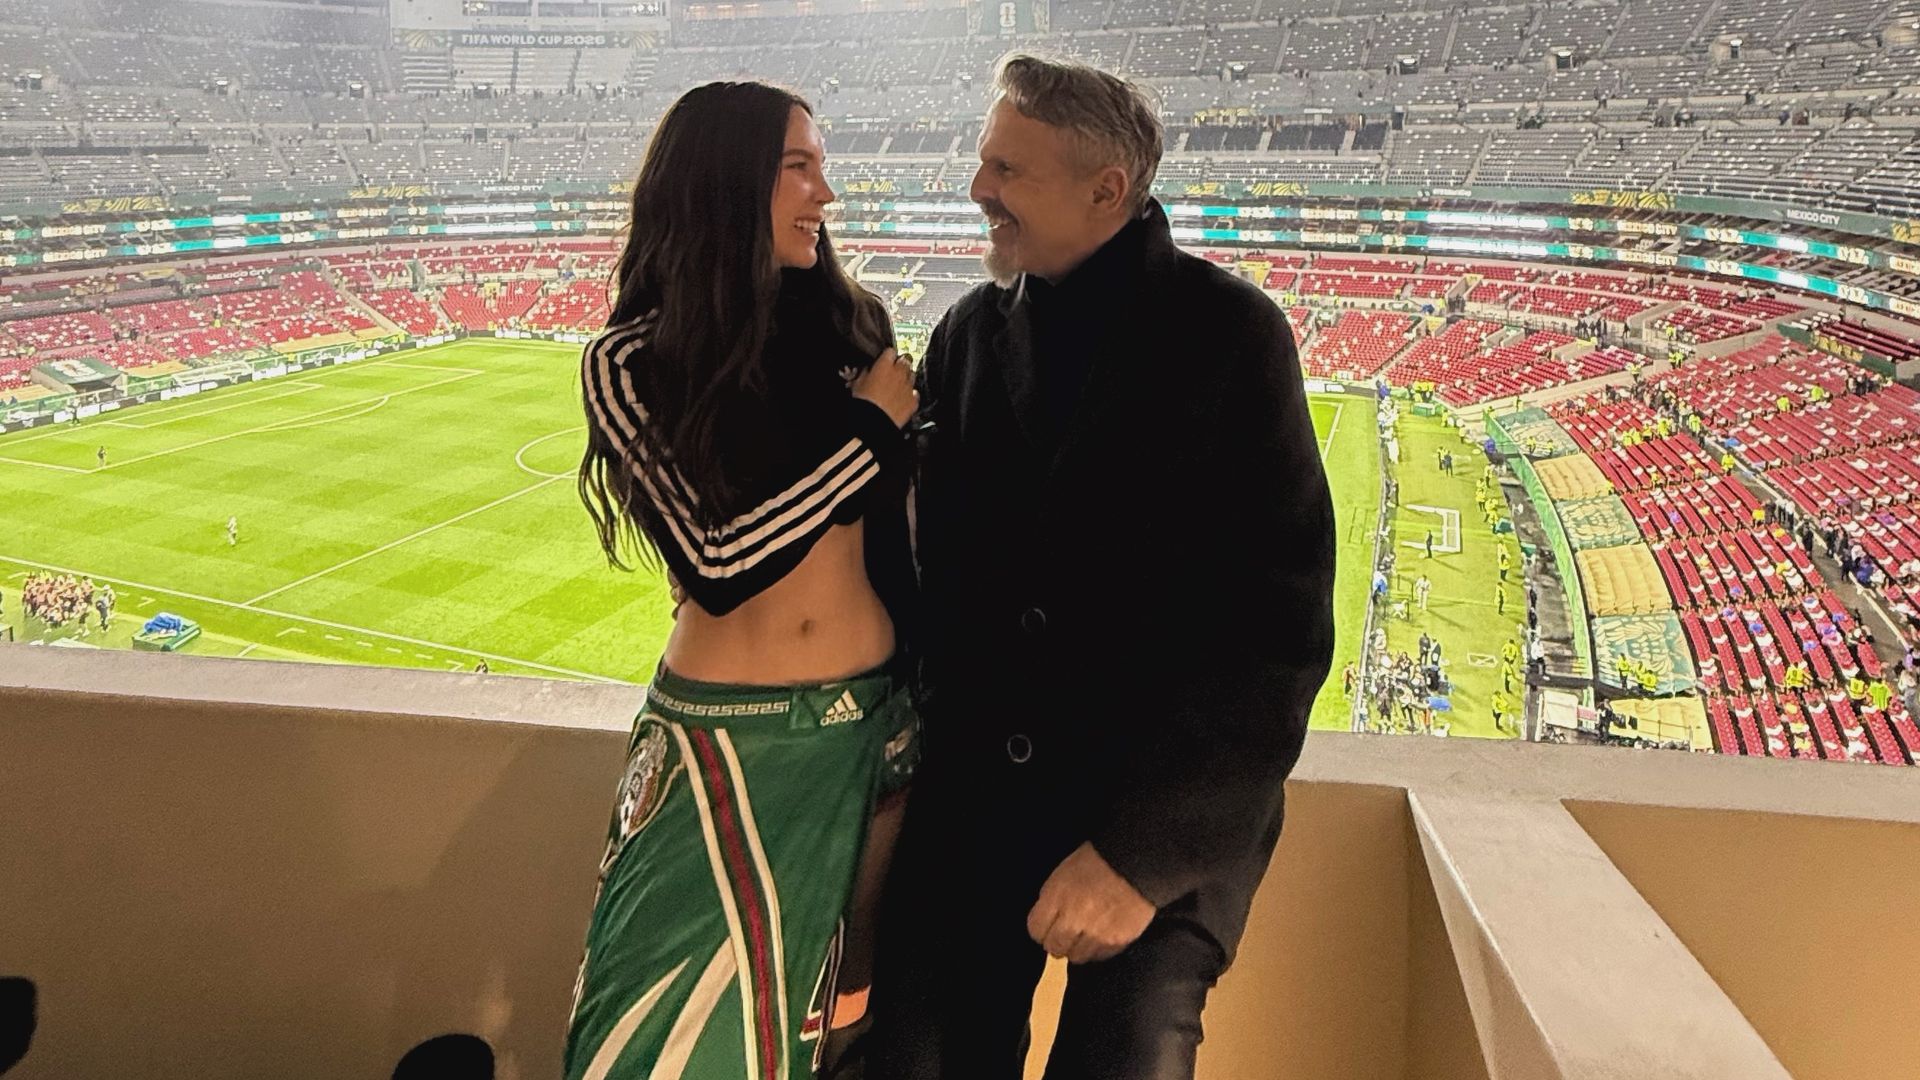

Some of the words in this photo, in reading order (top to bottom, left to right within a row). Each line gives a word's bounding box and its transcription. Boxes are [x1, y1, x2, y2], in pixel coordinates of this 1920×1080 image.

[461, 34, 489, 45] FIFA
[490, 34, 536, 45] WORLD
[537, 34, 562, 45] CUP
[564, 36, 606, 45] 2026
[1787, 208, 1819, 223] MEXICO
[1819, 214, 1840, 226] CITY
[1655, 223, 1678, 235] CITY
[1655, 253, 1678, 265] CITY
[206, 270, 248, 281] MEXICO
[249, 267, 274, 277] CITY
[820, 709, 864, 726] adidas
